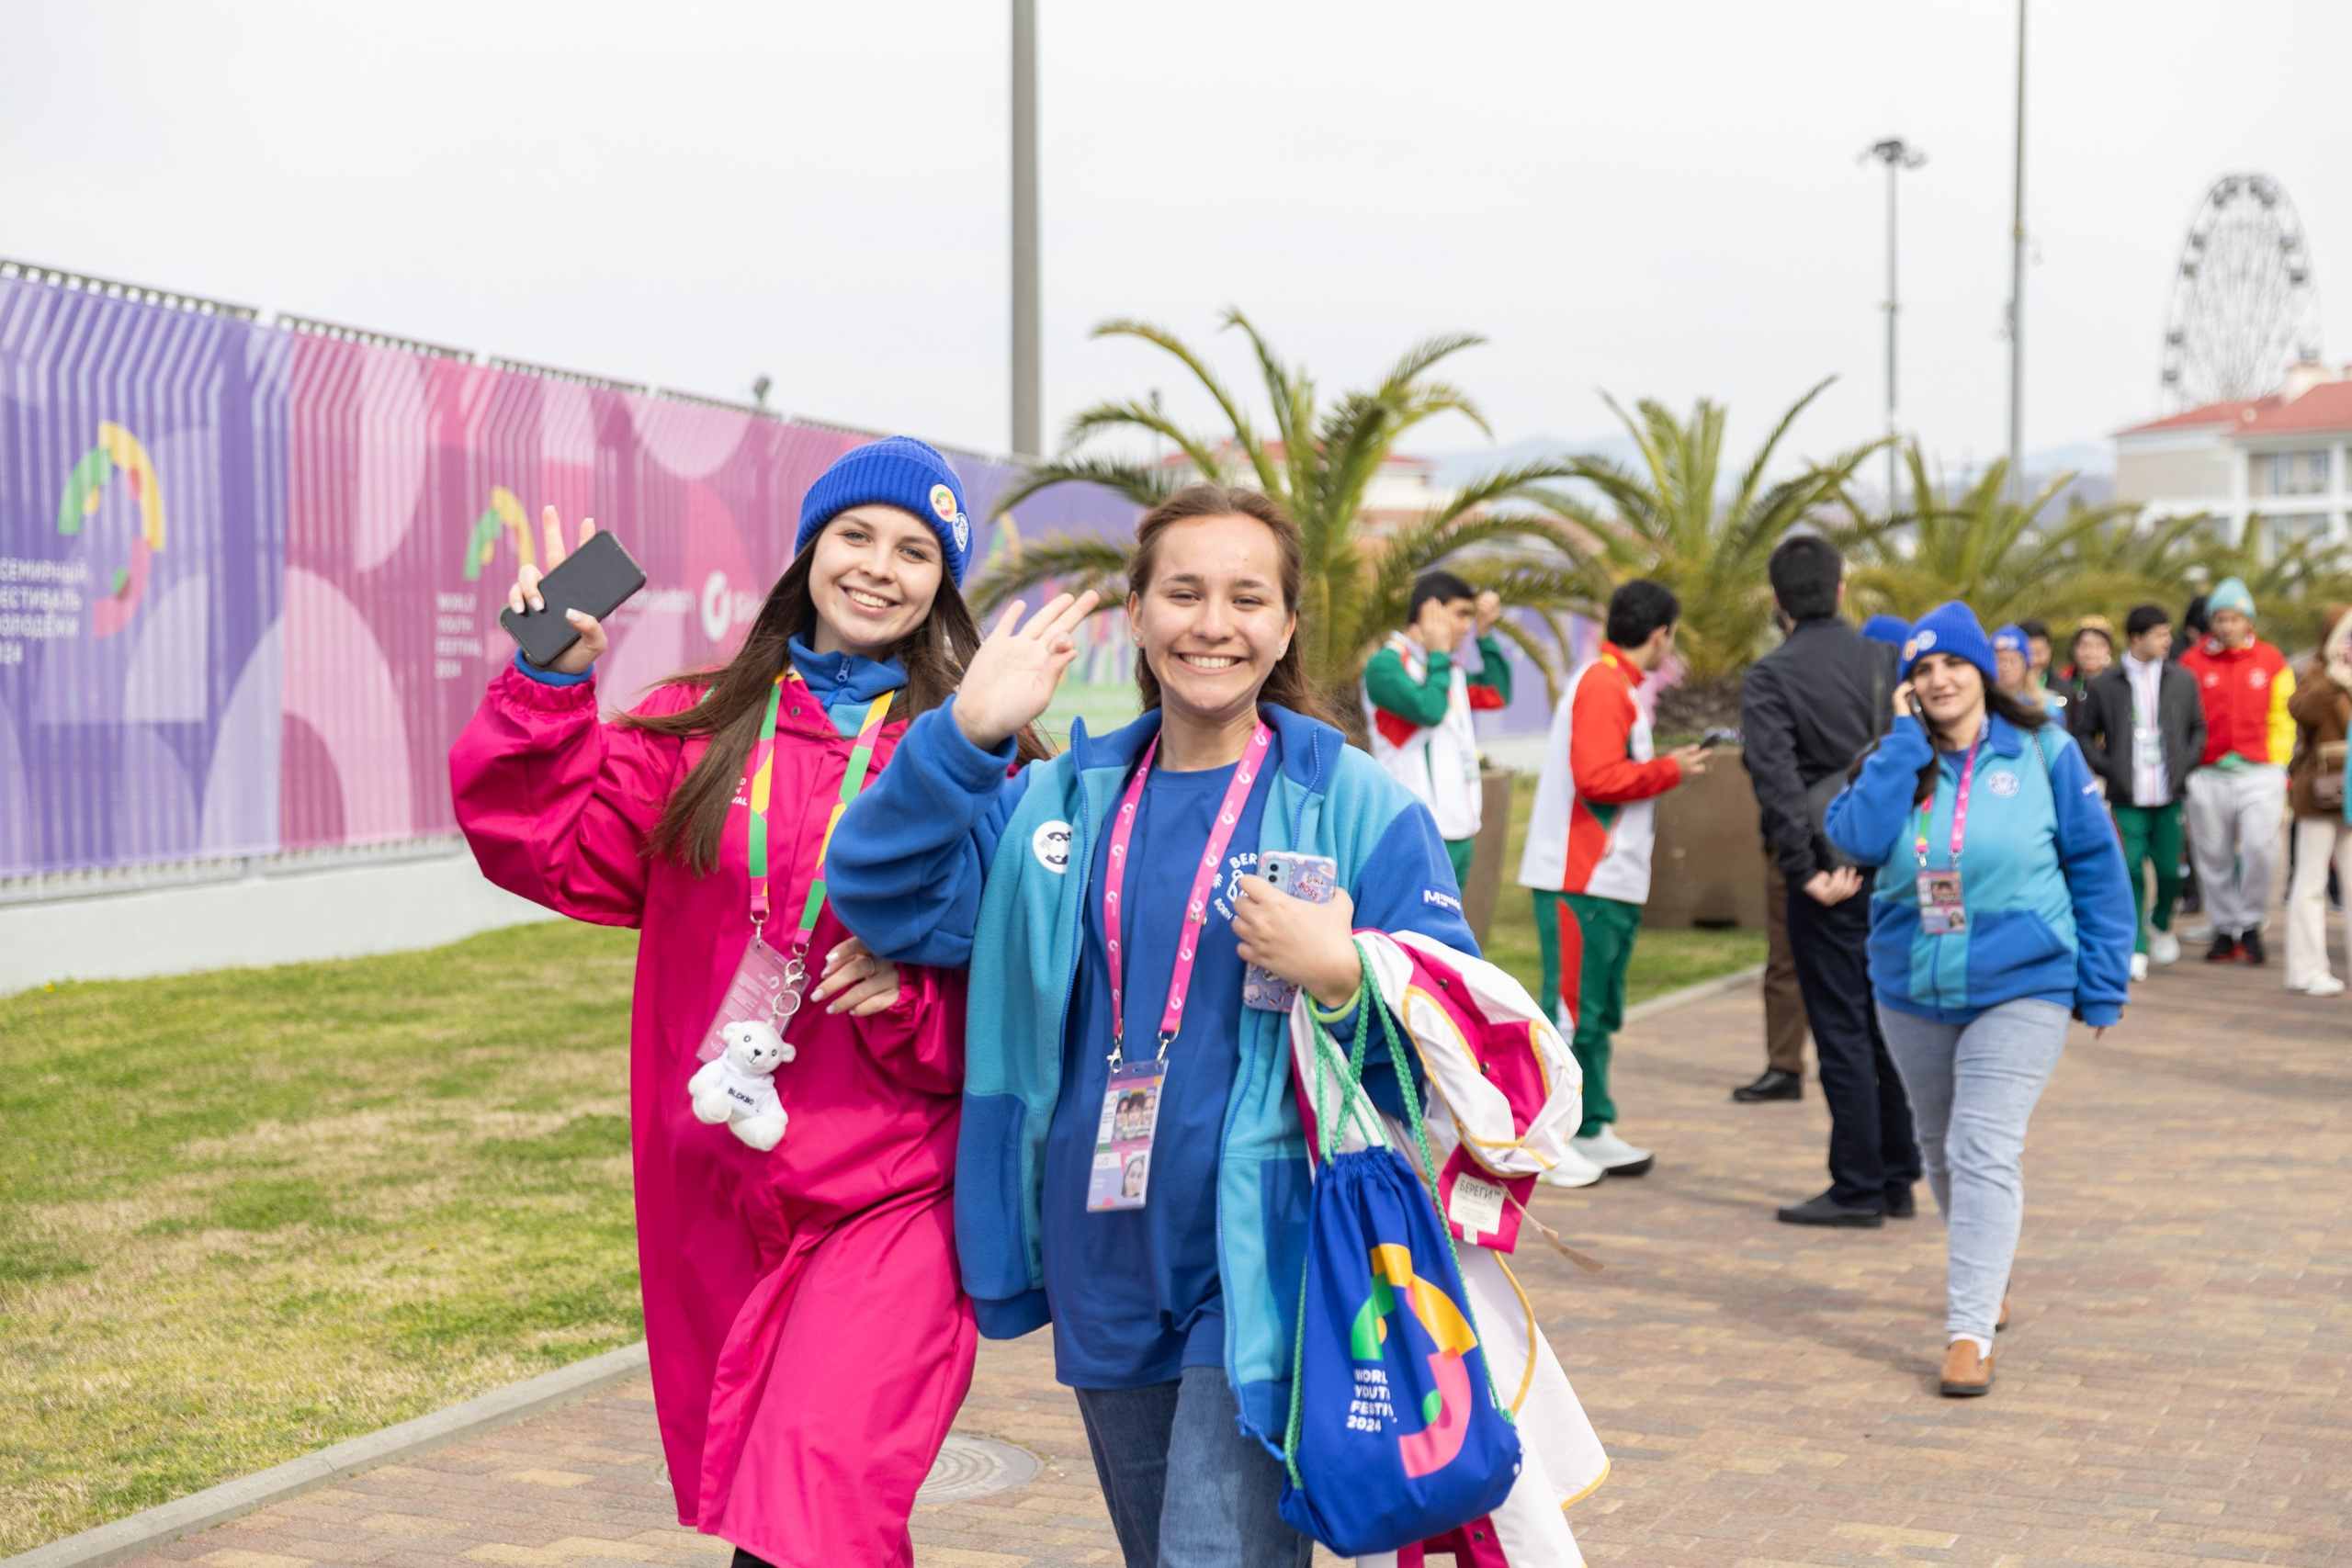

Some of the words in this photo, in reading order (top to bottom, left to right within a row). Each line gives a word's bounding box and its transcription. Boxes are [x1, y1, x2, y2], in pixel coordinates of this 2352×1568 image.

[0, 557, 88, 583] СЕМИРНЫЙ
[0, 585, 82, 611] ЕСТИВАЛЬ
[0, 611, 80, 640] ОЛОДЁЖИ
[1229, 852, 1258, 869] BER
[1354, 1369, 1388, 1384] WORL
[1350, 1400, 1395, 1418] FESTI
[1346, 1414, 1381, 1433] 2024
